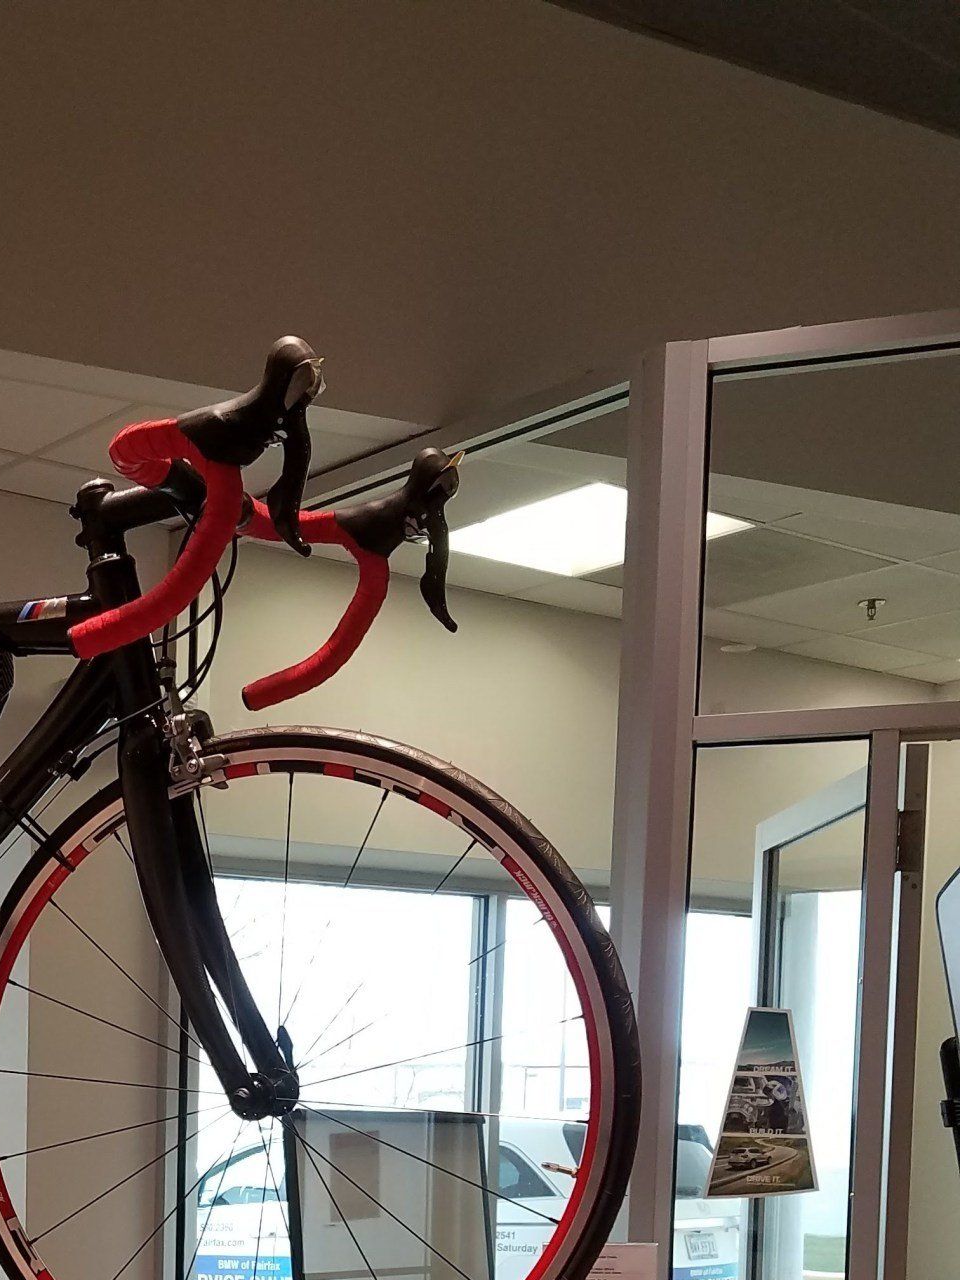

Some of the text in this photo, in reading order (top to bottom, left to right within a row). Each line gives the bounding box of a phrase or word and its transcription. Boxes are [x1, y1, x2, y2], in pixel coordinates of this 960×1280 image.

[496, 1243, 538, 1255] Saturday
[218, 1259, 281, 1271] BMW of Fairfax
